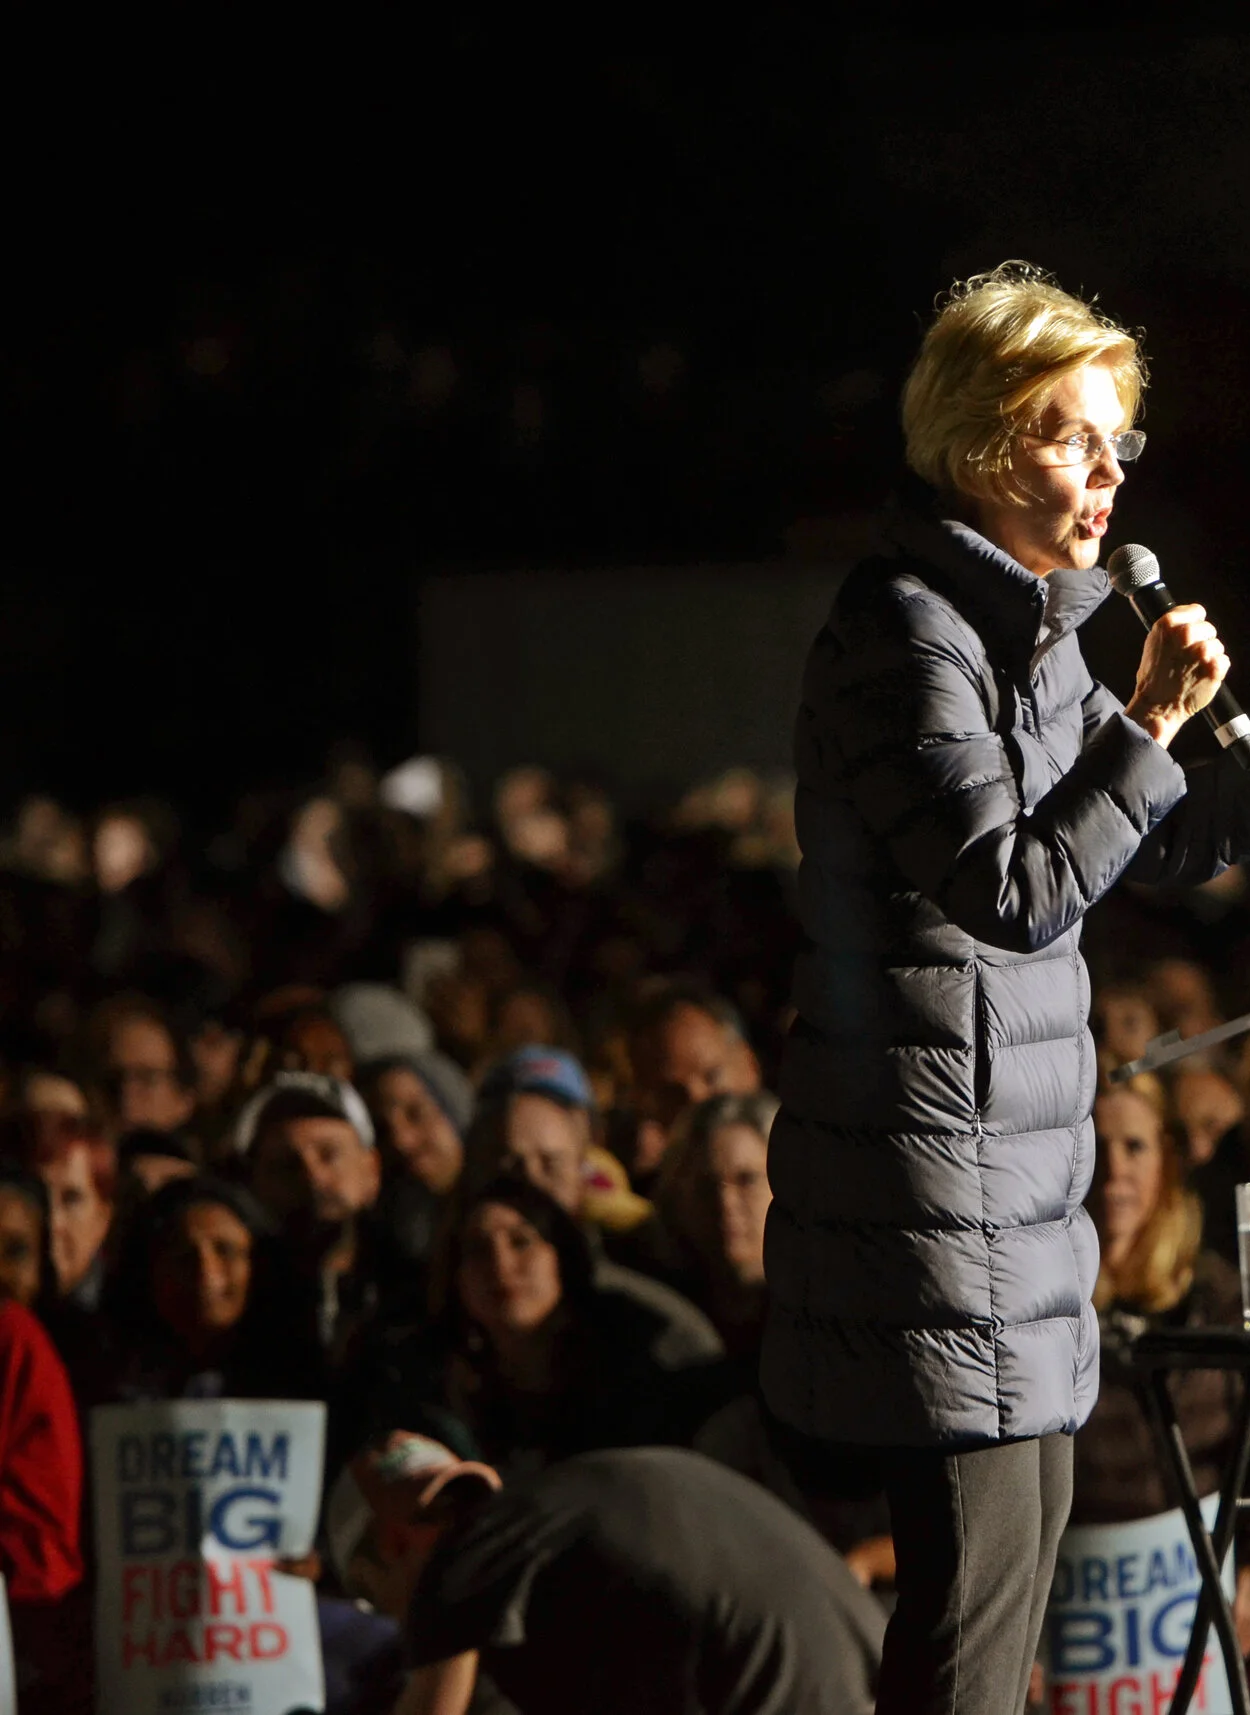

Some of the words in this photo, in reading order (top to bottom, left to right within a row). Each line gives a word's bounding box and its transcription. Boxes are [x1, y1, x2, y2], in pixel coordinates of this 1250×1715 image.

[117, 1430, 291, 1481] DREAM
[121, 1487, 283, 1557] BIG
[122, 1560, 277, 1623] FIGHT
[122, 1622, 291, 1670] HARD
[1051, 1592, 1201, 1674] BIG
